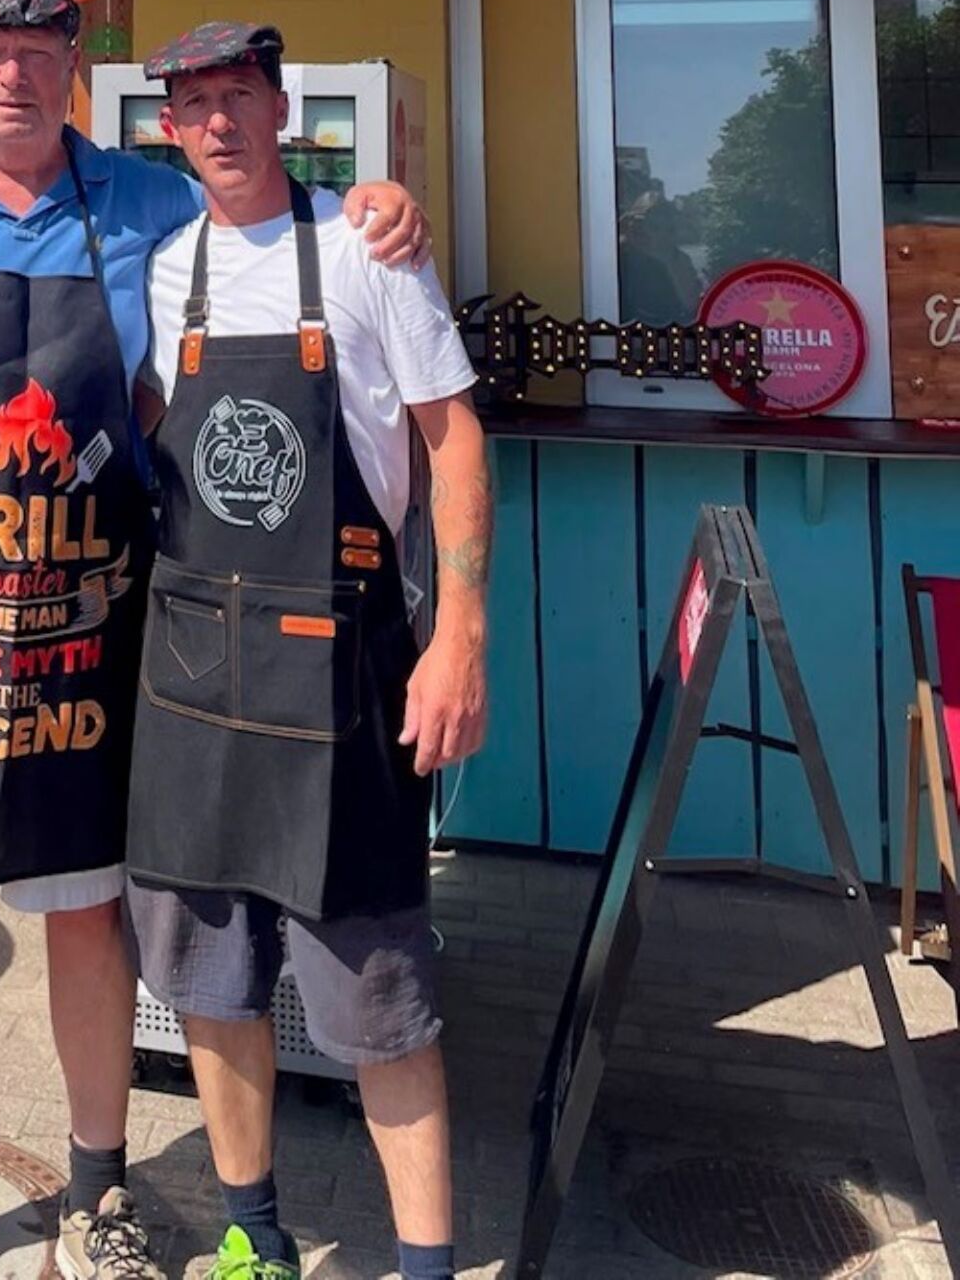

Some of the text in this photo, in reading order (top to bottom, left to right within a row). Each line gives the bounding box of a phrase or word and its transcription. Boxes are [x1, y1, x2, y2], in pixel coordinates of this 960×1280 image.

[763, 328, 833, 347] RELLA
[764, 362, 822, 372] CELONA
[203, 435, 296, 505] Chef
[21, 604, 68, 631] MAN
[9, 634, 103, 679] MYTH
